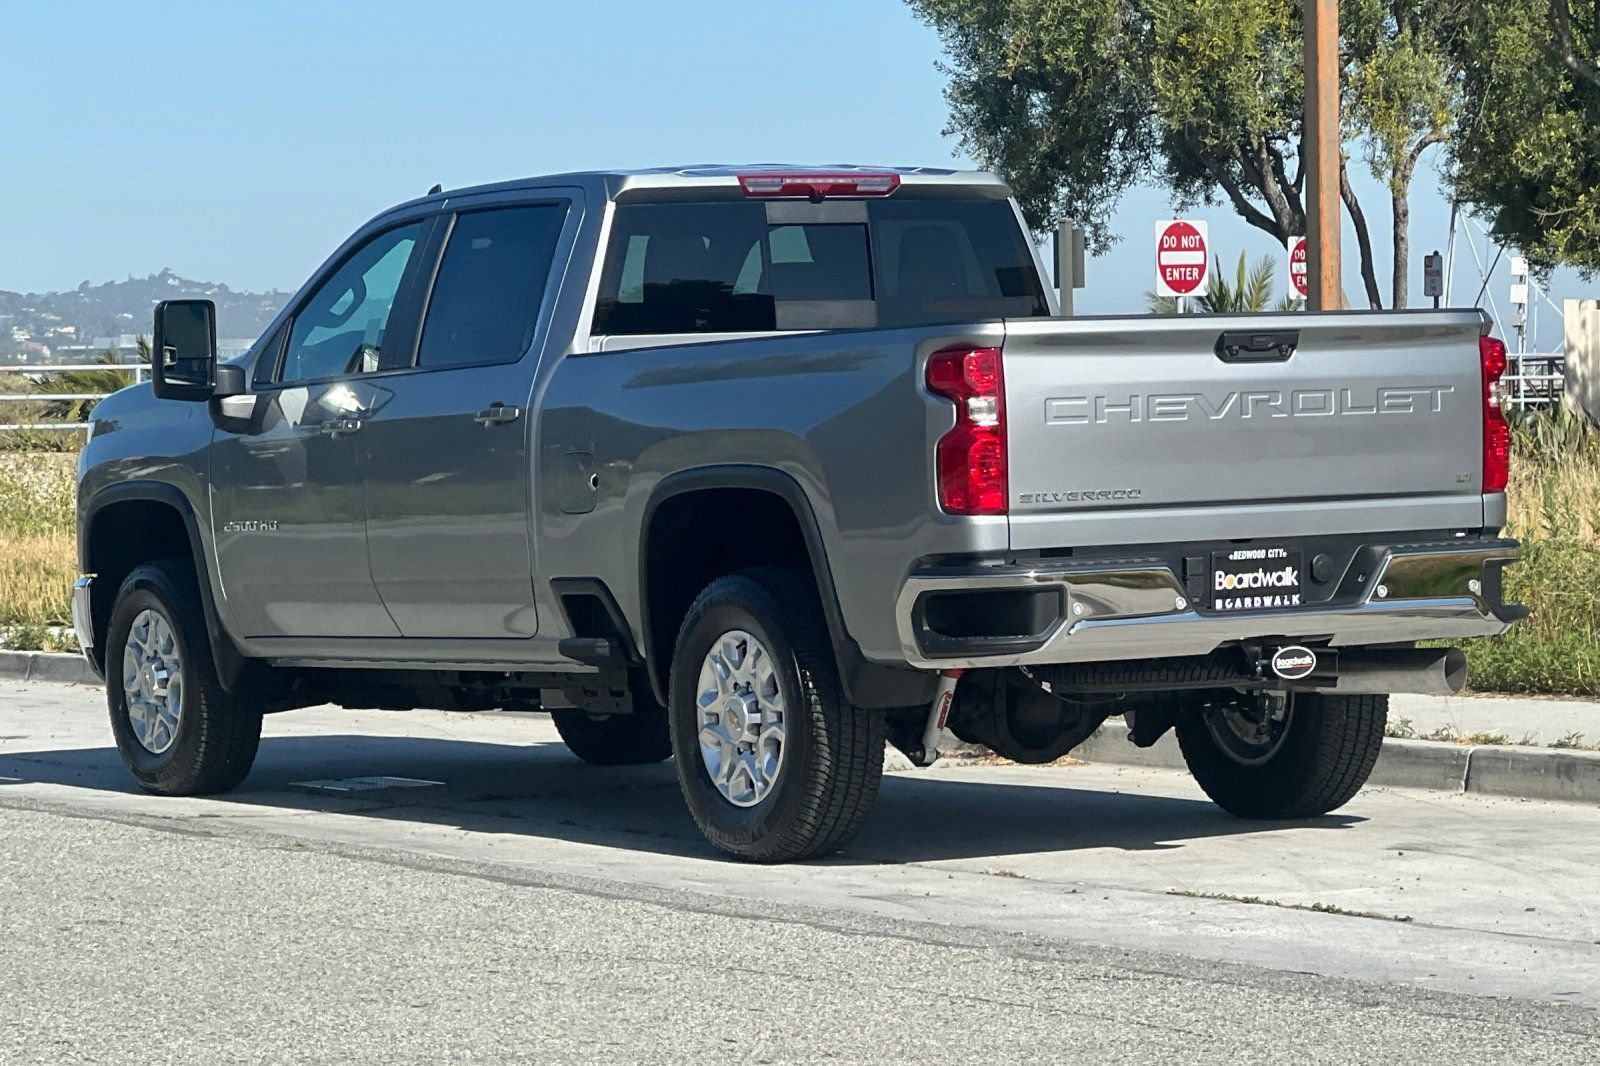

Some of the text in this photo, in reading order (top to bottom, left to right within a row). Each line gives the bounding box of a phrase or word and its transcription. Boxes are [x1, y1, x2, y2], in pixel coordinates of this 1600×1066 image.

[1163, 235, 1200, 249] DO NOT
[1166, 267, 1199, 281] ENTER
[1044, 386, 1454, 425] CHEVROLET
[1019, 488, 1141, 503] SILVERADO
[1233, 548, 1284, 560] REDWOOD CITY
[1215, 566, 1299, 590] Boardwalk
